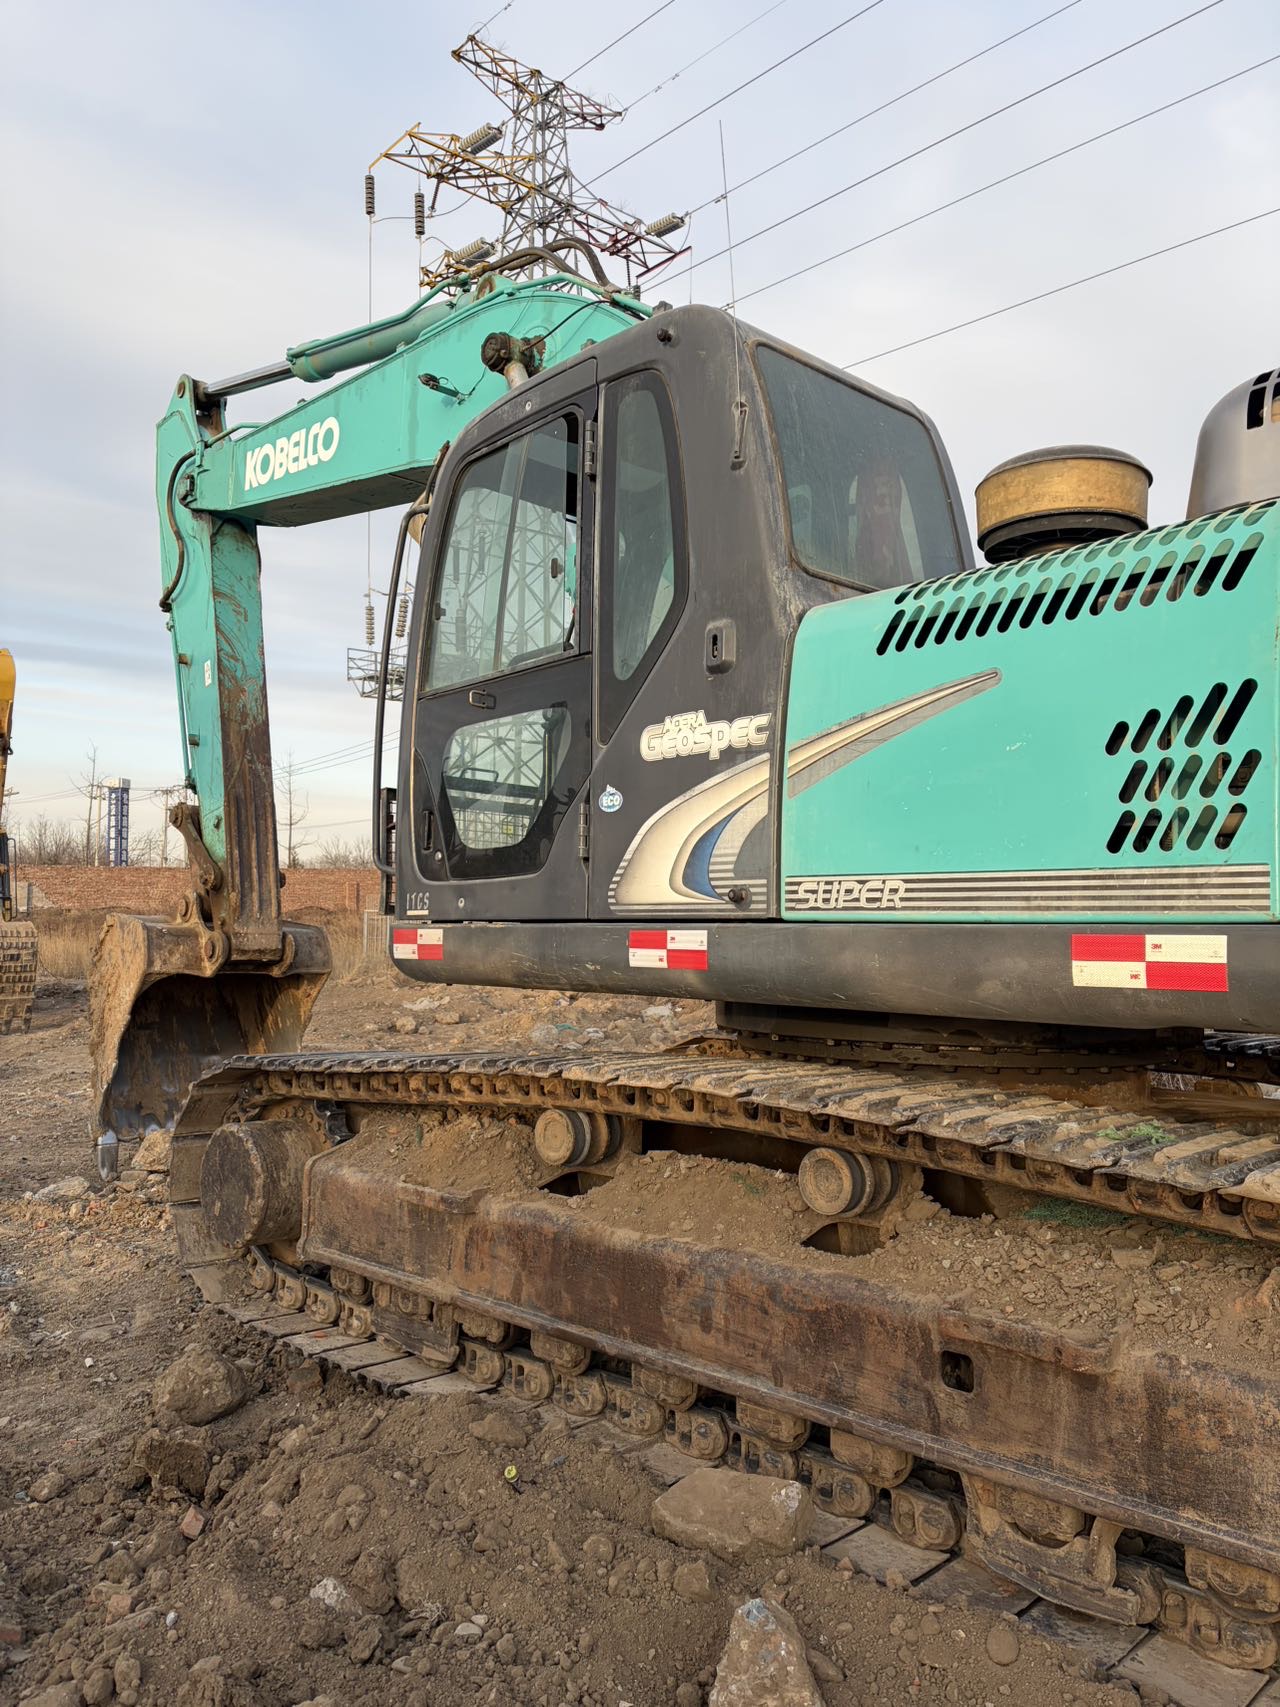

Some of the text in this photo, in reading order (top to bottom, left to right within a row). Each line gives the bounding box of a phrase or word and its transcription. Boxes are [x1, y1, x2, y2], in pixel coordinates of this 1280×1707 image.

[244, 416, 340, 491] KOBELCO
[663, 710, 707, 735] ACERA
[602, 795, 621, 806] ECO
[795, 879, 906, 909] SUPER
